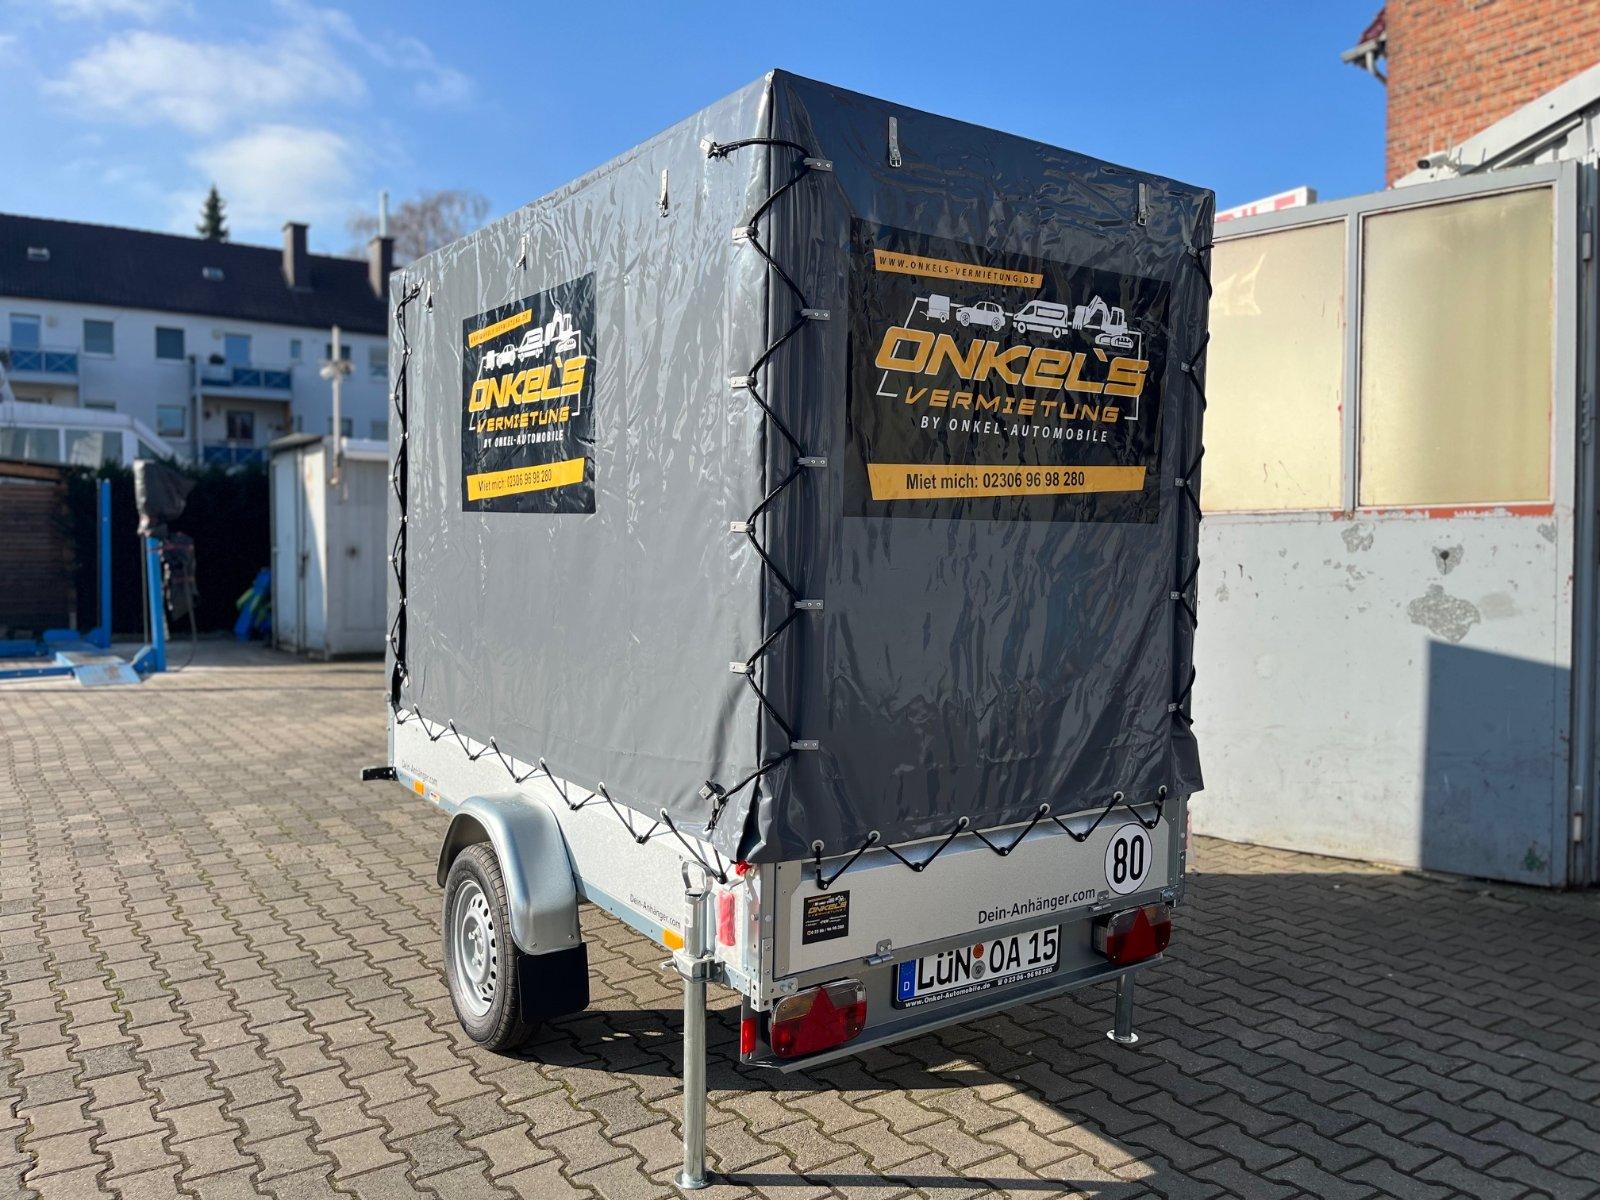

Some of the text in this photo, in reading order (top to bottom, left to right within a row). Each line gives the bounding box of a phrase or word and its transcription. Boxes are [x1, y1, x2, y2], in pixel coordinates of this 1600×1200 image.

[879, 256, 1036, 284] WWW.ONKELS-VERMIETUNG.DE
[905, 386, 1120, 423] VERMIETUNG
[476, 406, 570, 433] VERMIETUNG
[920, 415, 1108, 443] BY ONKEL-AUTOMOBILE
[494, 430, 564, 448] ONKEL-AUTOMOBILE
[524, 473, 532, 485] 96
[541, 469, 552, 483] 280
[906, 471, 1085, 490] Miet mich: 02306 96 98 280
[1113, 834, 1144, 884] 80
[978, 888, 1096, 924] Dein-Anhänger.com
[917, 928, 1058, 990] LÜN OA 15
[903, 981, 910, 991] D
